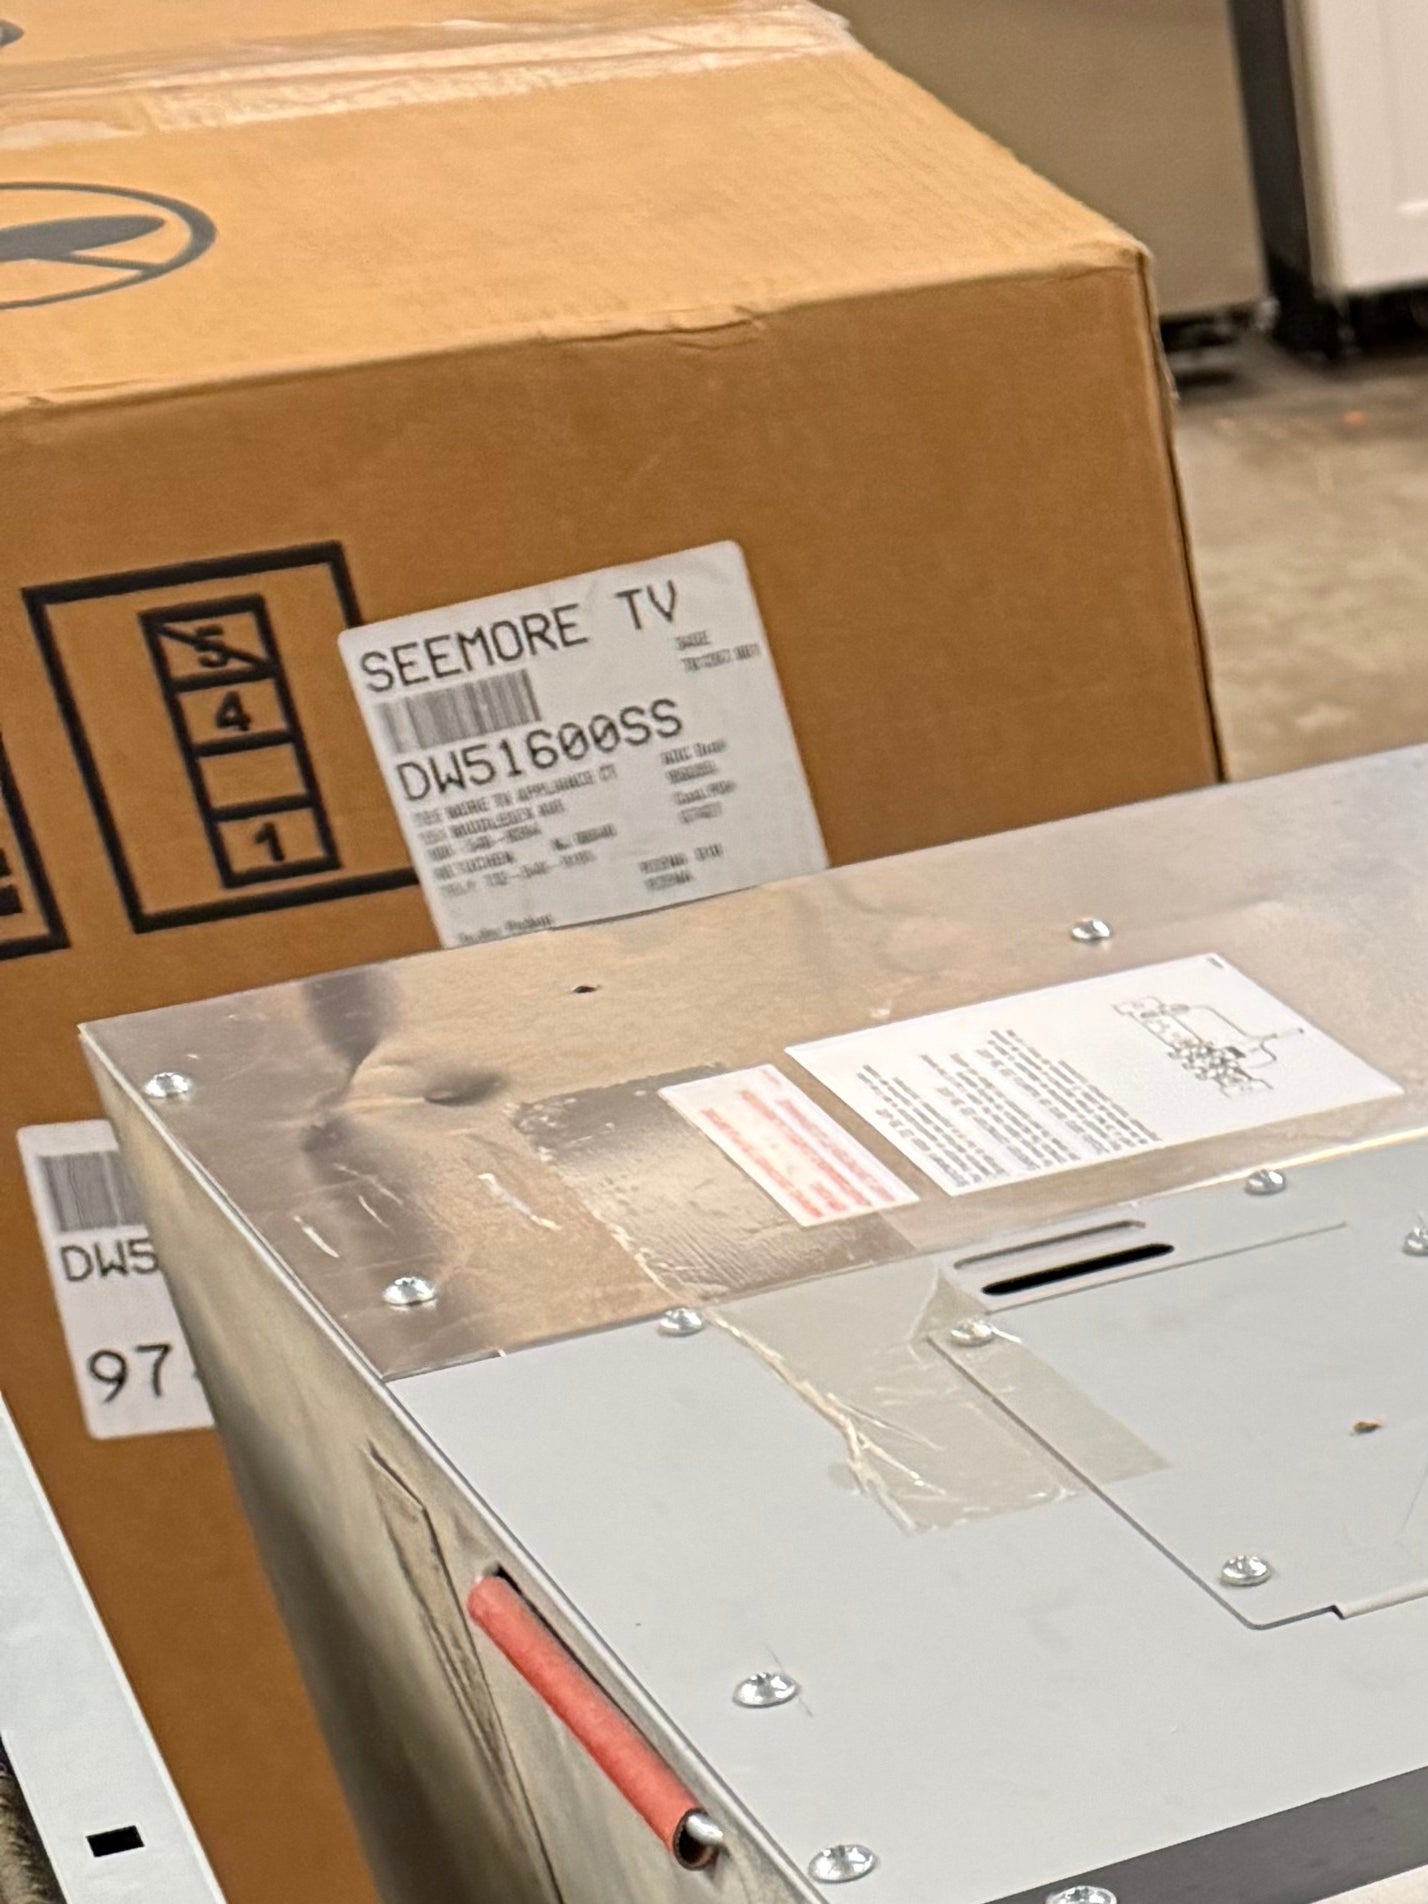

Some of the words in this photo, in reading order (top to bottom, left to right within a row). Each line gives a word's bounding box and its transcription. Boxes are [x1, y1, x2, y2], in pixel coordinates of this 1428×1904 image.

[361, 603, 588, 693] SEEMORE
[616, 580, 679, 631] TV
[215, 691, 251, 731] 4
[398, 699, 684, 802] DW51600SS
[254, 821, 285, 863] 1
